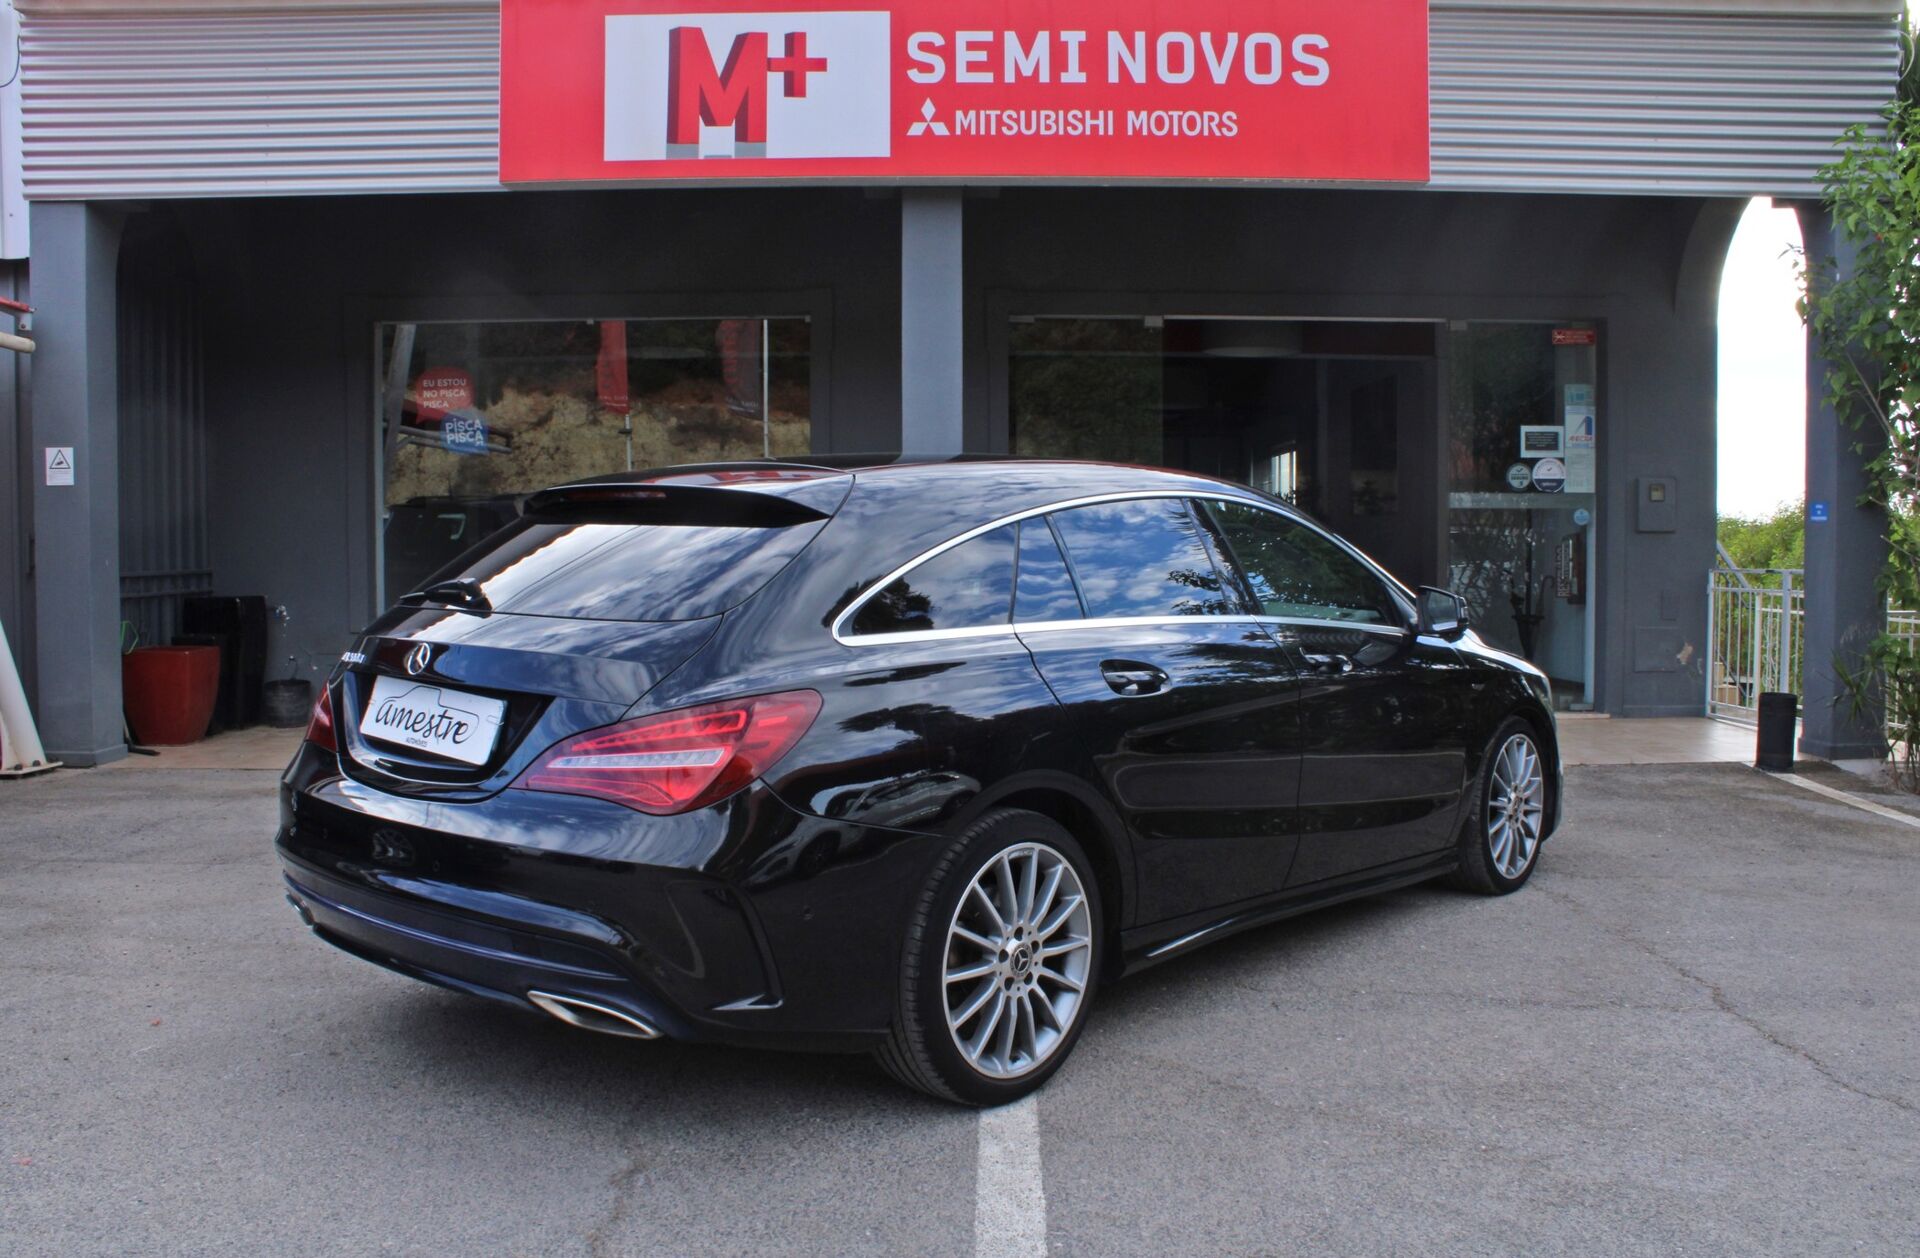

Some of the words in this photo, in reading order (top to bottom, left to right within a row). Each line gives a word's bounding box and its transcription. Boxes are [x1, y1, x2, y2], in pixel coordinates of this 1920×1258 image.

[906, 30, 1087, 84] SEMI
[1107, 31, 1330, 86] NOVOS
[955, 109, 1114, 135] MITSUBISHI
[1127, 110, 1238, 137] MOTORS
[423, 379, 435, 387] EU
[437, 378, 466, 387] ESTOU
[440, 389, 465, 397] PISCA
[423, 400, 449, 408] PISCA
[447, 430, 484, 444] PISCA
[375, 699, 470, 745] amestre
